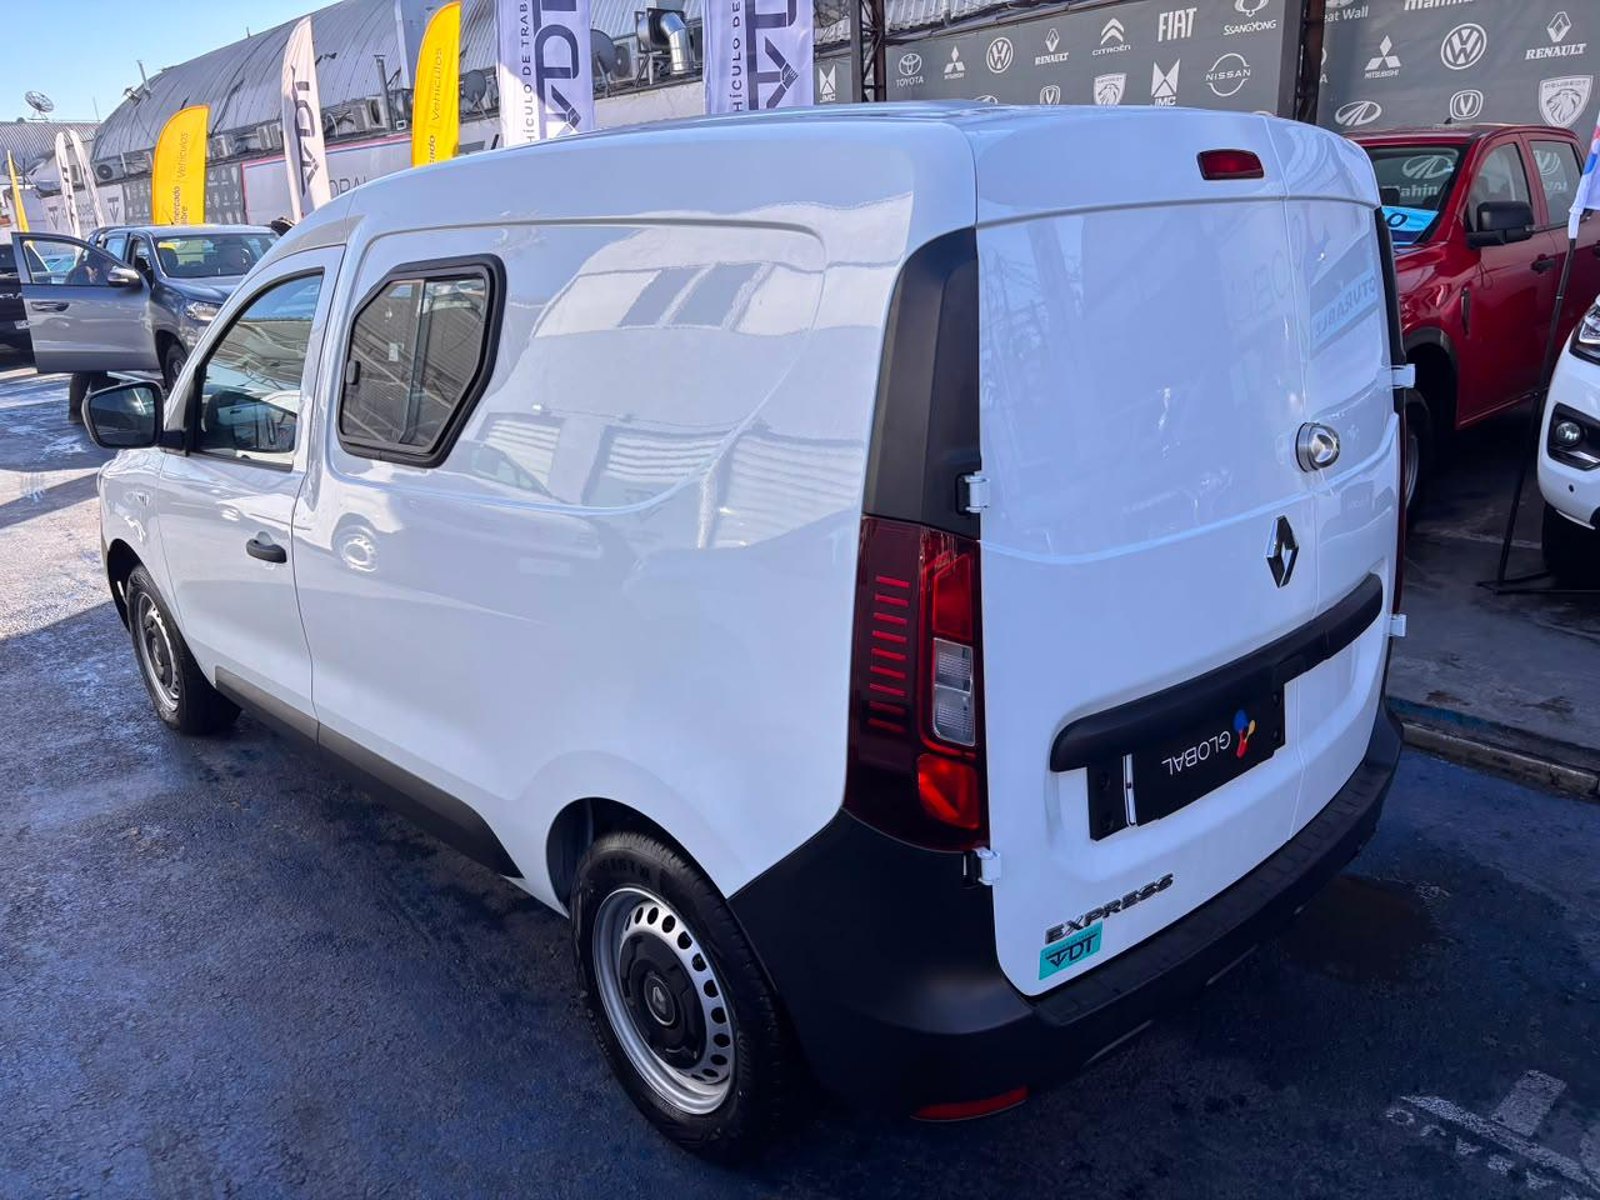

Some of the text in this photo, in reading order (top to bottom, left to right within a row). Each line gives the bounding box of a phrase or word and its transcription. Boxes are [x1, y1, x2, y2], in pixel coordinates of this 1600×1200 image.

[1157, 7, 1198, 43] FIAT
[1342, 5, 1369, 20] Wall
[730, 2, 743, 112] HÍCULO DE
[1034, 52, 1070, 66] RENAULT
[1524, 43, 1587, 61] RENAULT
[519, 0, 536, 142] HÍCULO DE TRAB
[895, 75, 924, 87] TOYOTA
[1205, 68, 1251, 82] NISSAN
[1161, 730, 1231, 776] GLOBAL
[1045, 872, 1174, 945] EXPRESS
